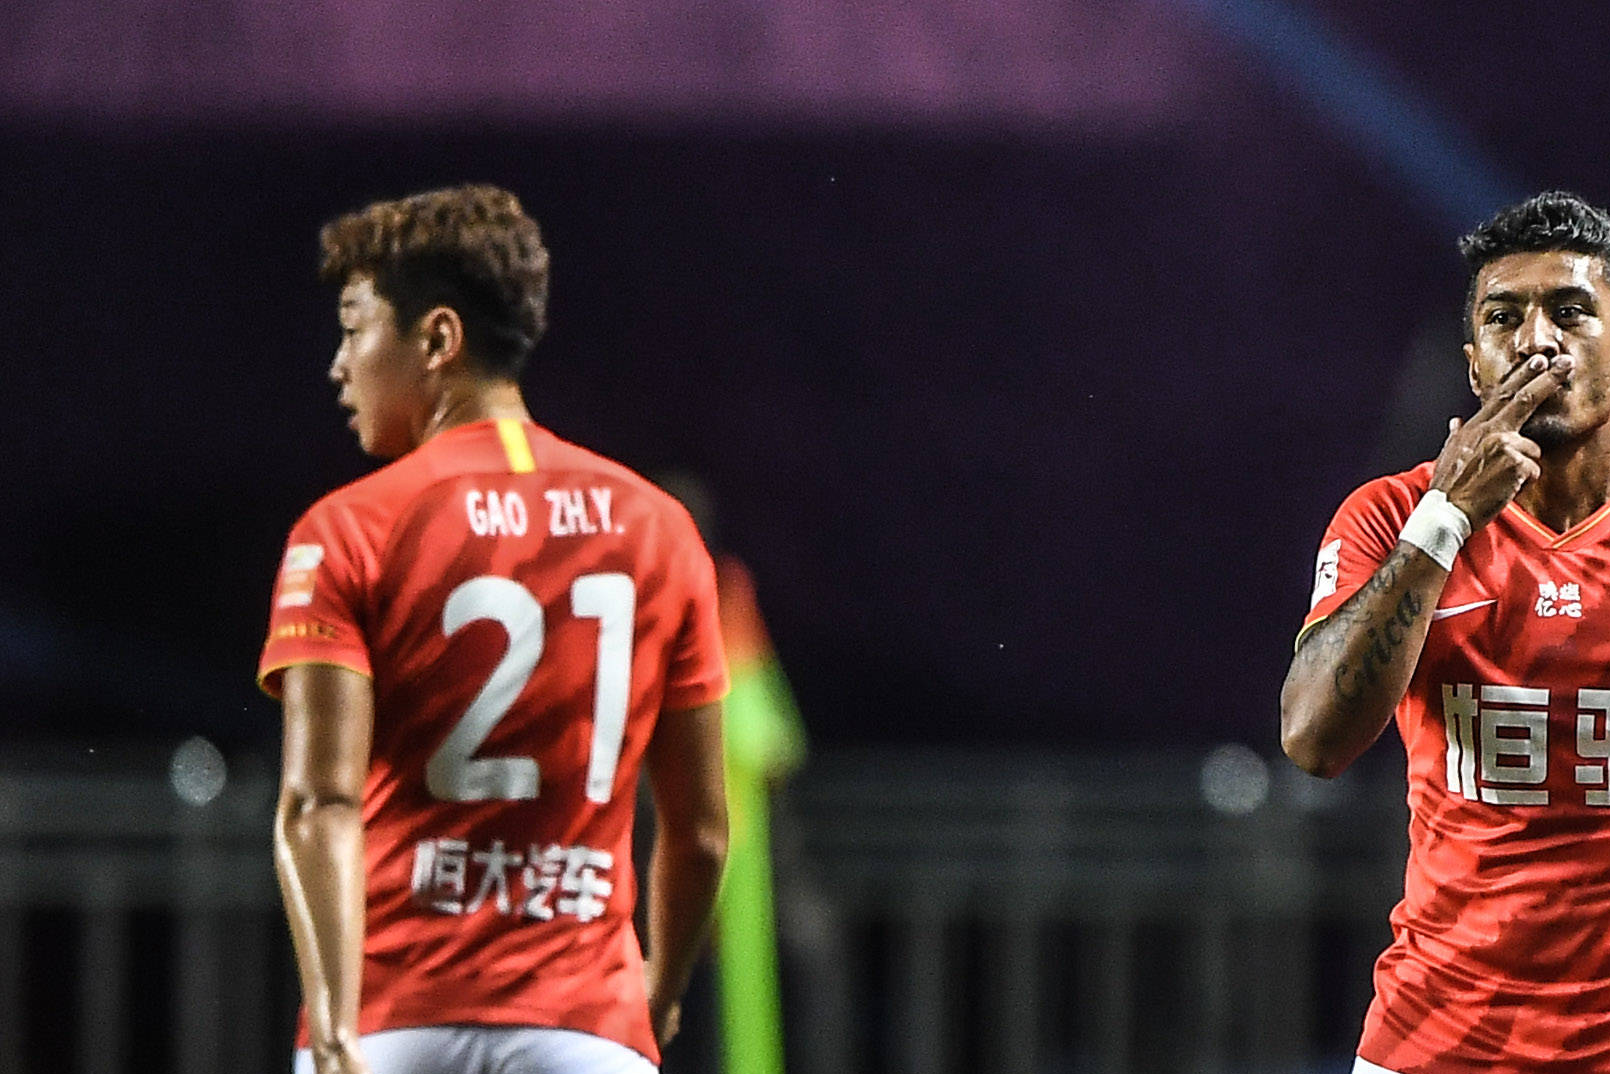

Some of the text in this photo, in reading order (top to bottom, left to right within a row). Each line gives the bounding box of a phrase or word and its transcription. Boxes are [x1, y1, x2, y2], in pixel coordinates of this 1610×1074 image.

[465, 488, 528, 537] GAO
[426, 573, 636, 805] 21
[411, 838, 614, 923] 恒大汽车
